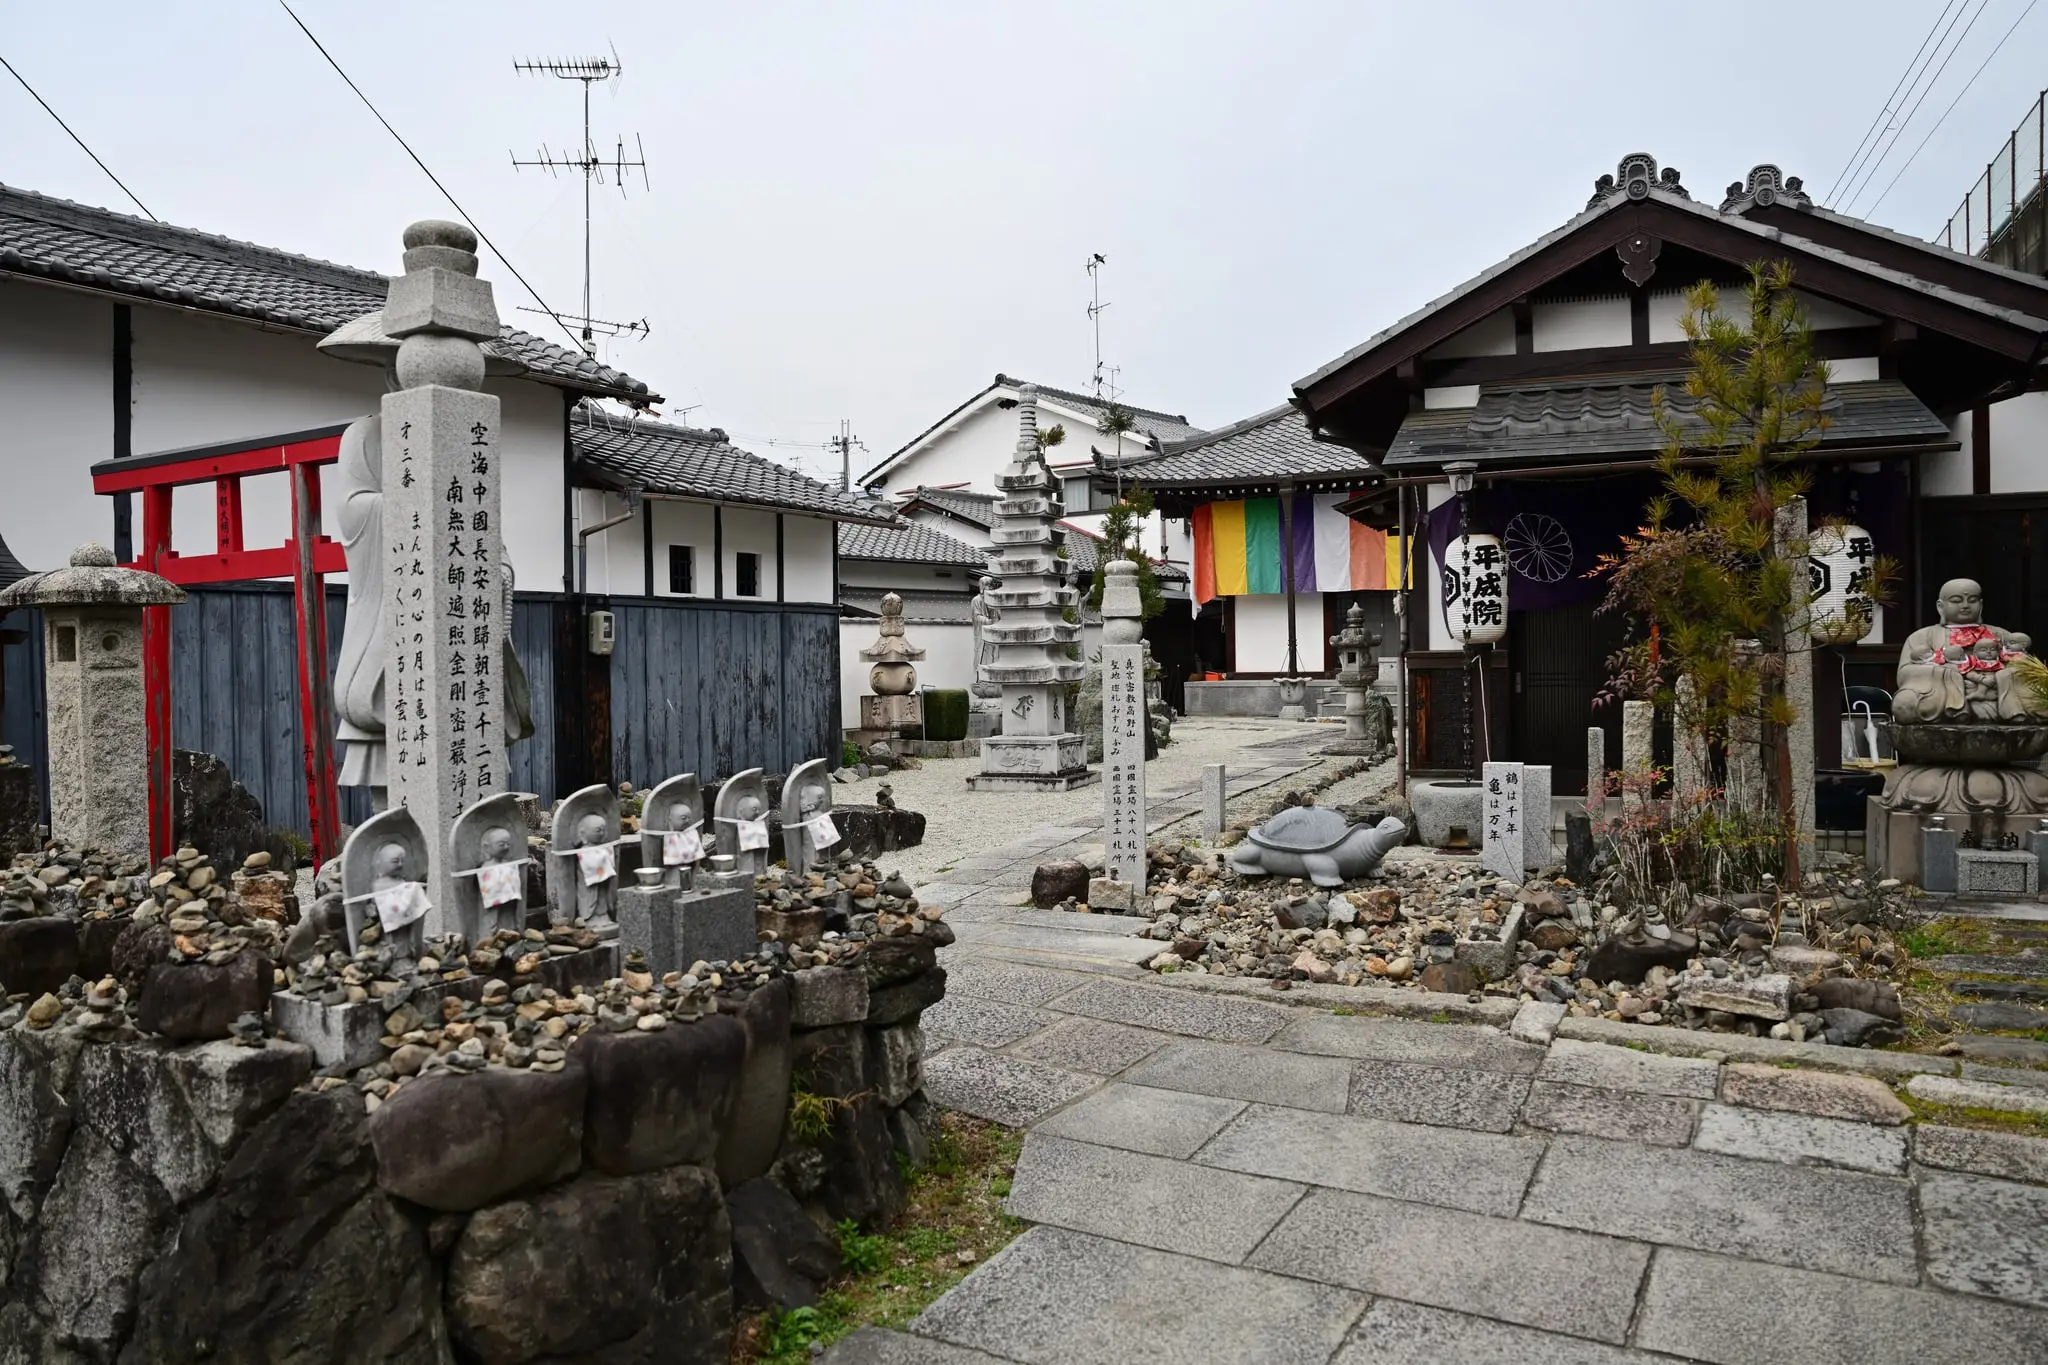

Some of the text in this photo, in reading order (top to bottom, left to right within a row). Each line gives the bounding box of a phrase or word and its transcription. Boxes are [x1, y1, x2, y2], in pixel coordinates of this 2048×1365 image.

[470, 421, 492, 802] 空海中國長安御歸朝壹千二百
[1472, 544, 1502, 625] 平成院
[1488, 778, 1503, 842] 亀は万年
[1505, 772, 1518, 835] 鶴は千年
